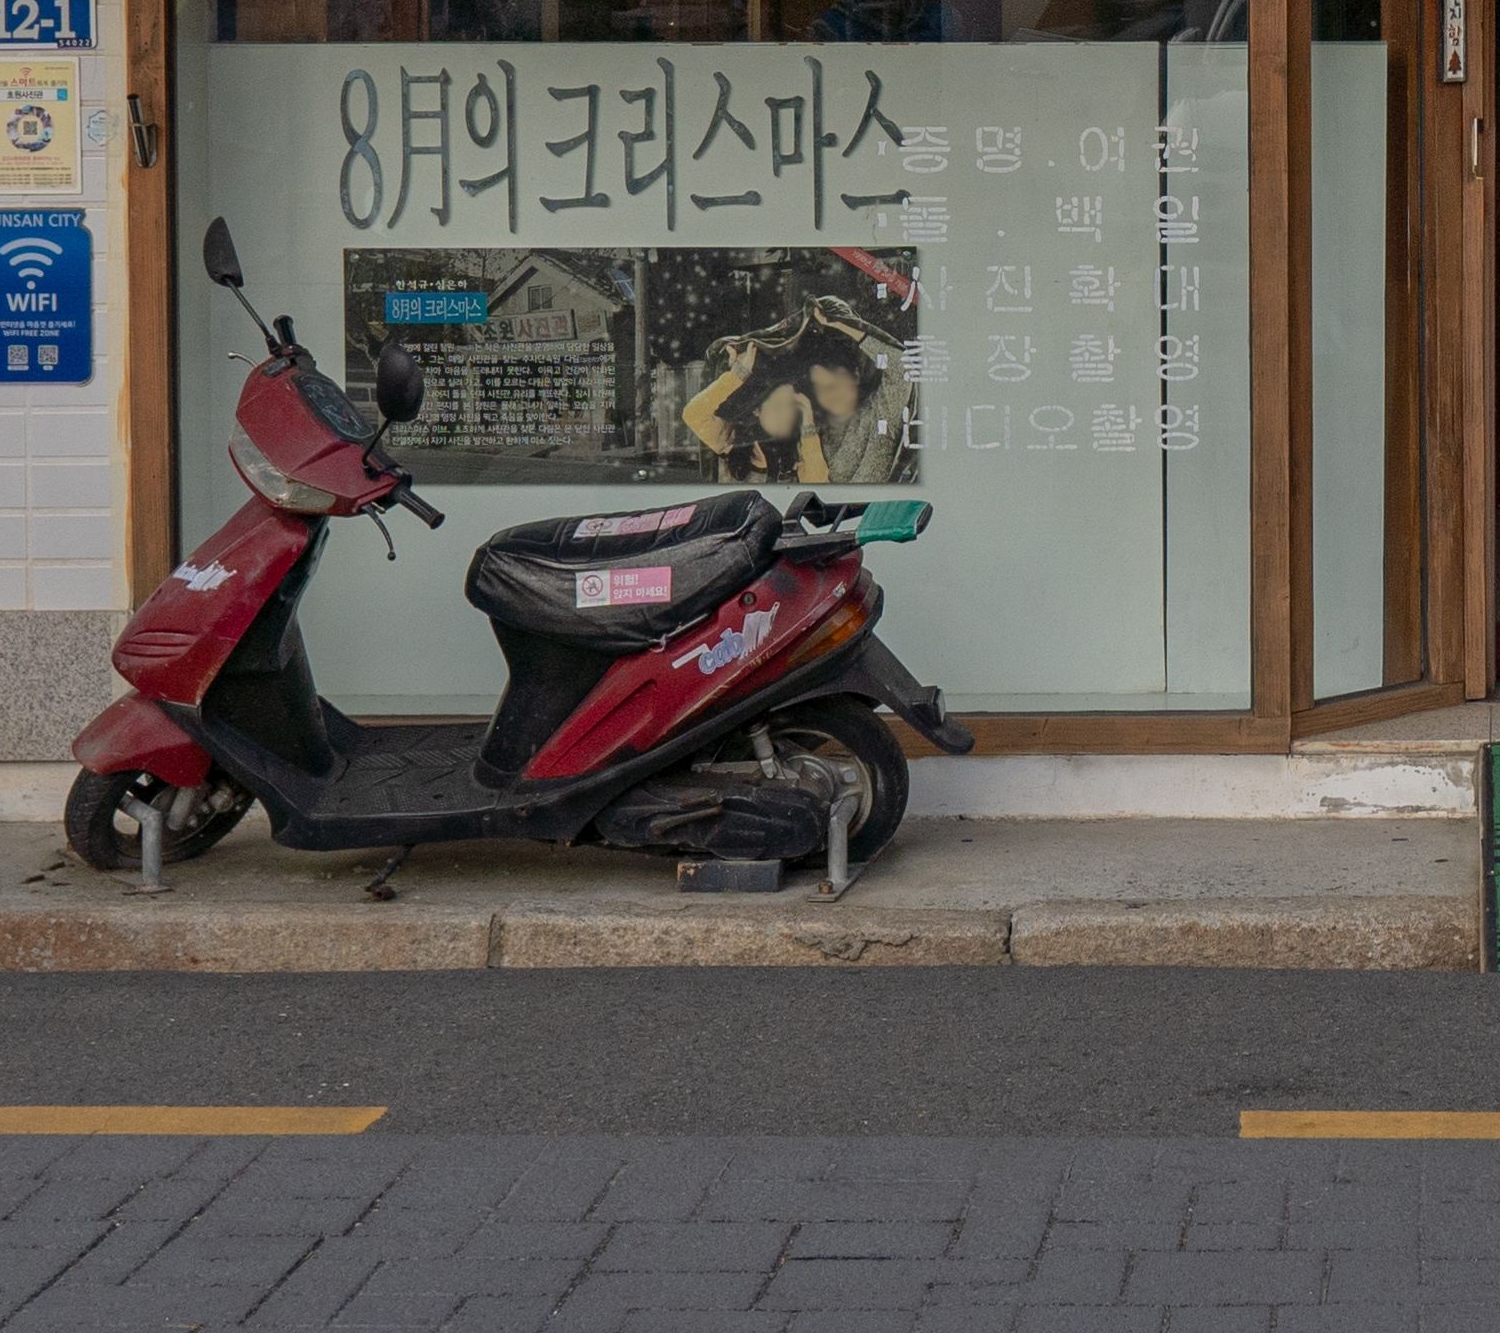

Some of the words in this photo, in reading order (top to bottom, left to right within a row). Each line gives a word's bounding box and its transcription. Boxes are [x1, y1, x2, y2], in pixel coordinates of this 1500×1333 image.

[6, 91, 44, 100] 초원사진관
[48, 214, 81, 227] CITY
[6, 292, 58, 312] WIFI
[392, 296, 421, 321] 8月의
[425, 296, 481, 321] 크리스마스
[21, 329, 38, 337] FREE
[39, 329, 60, 337] ZONE
